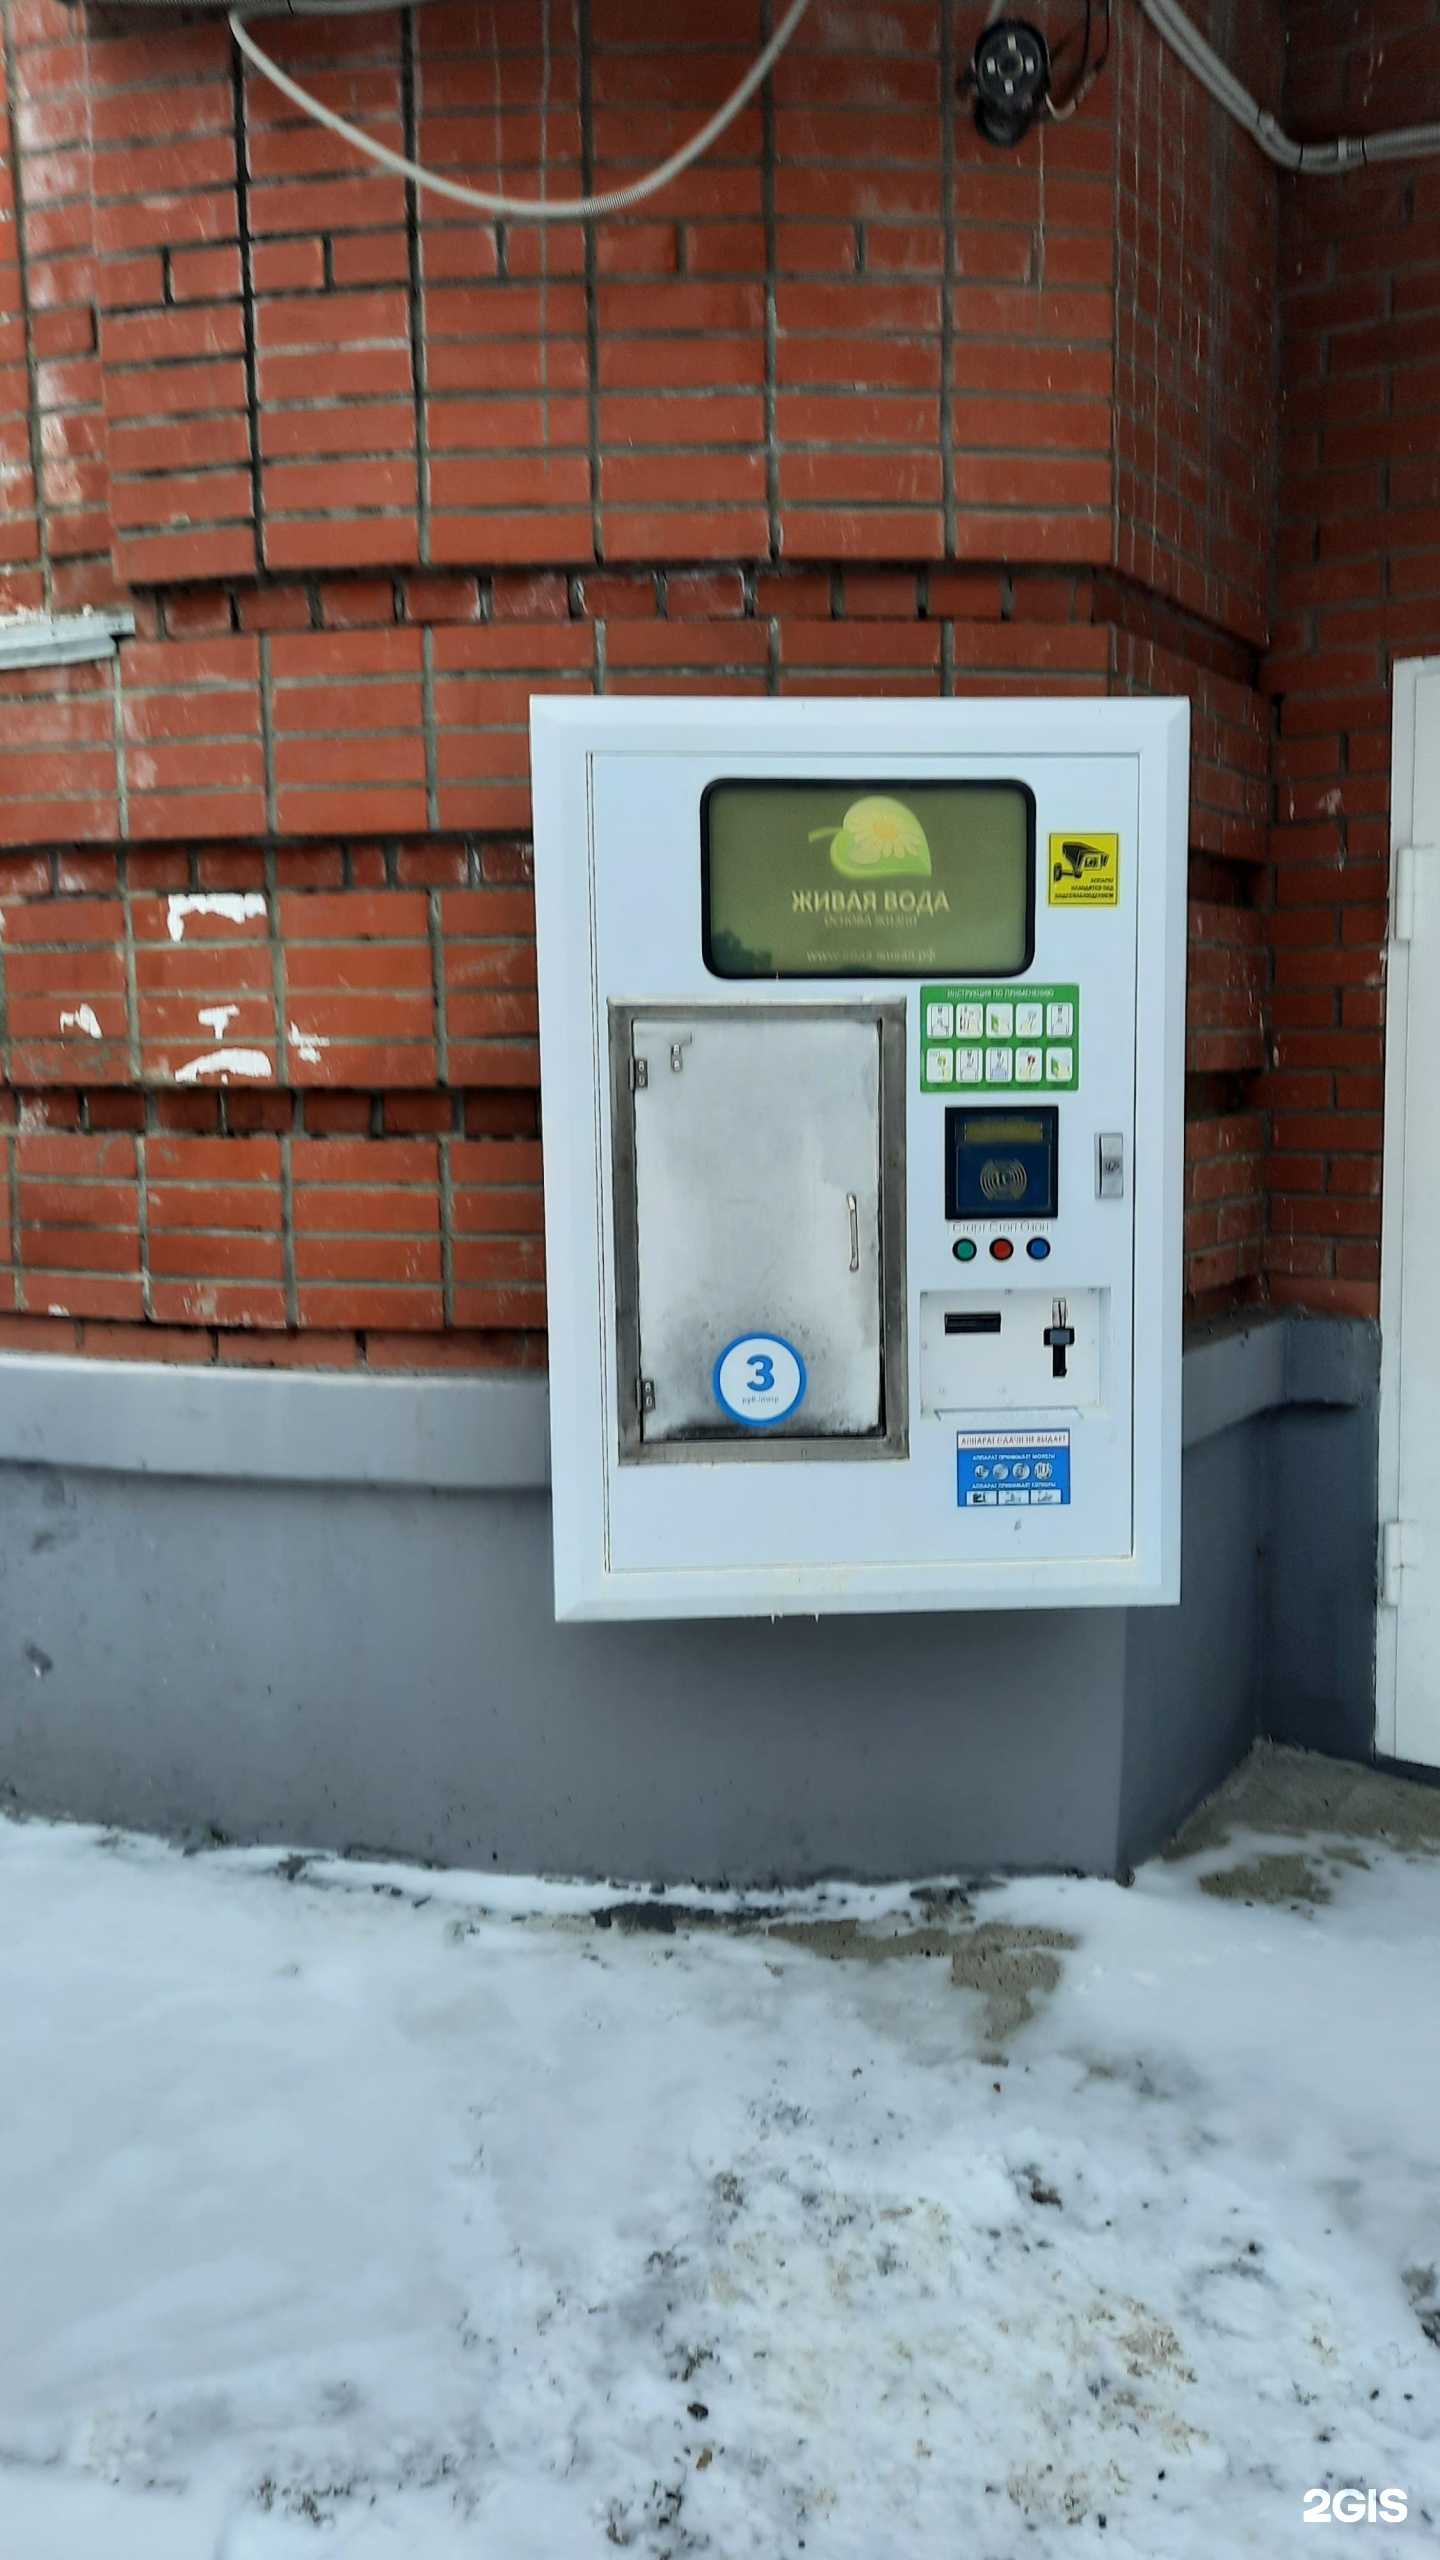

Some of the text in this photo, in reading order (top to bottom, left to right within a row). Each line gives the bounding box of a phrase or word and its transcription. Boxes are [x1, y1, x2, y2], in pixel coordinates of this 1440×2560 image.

[791, 889, 950, 917] ЖИВАЯ ВОДА
[946, 987, 992, 999] ИНСТРУКЦИЯ
[993, 987, 1004, 999] ПО
[746, 1354, 775, 1392] 3
[961, 1436, 995, 1446] АППАРАТ
